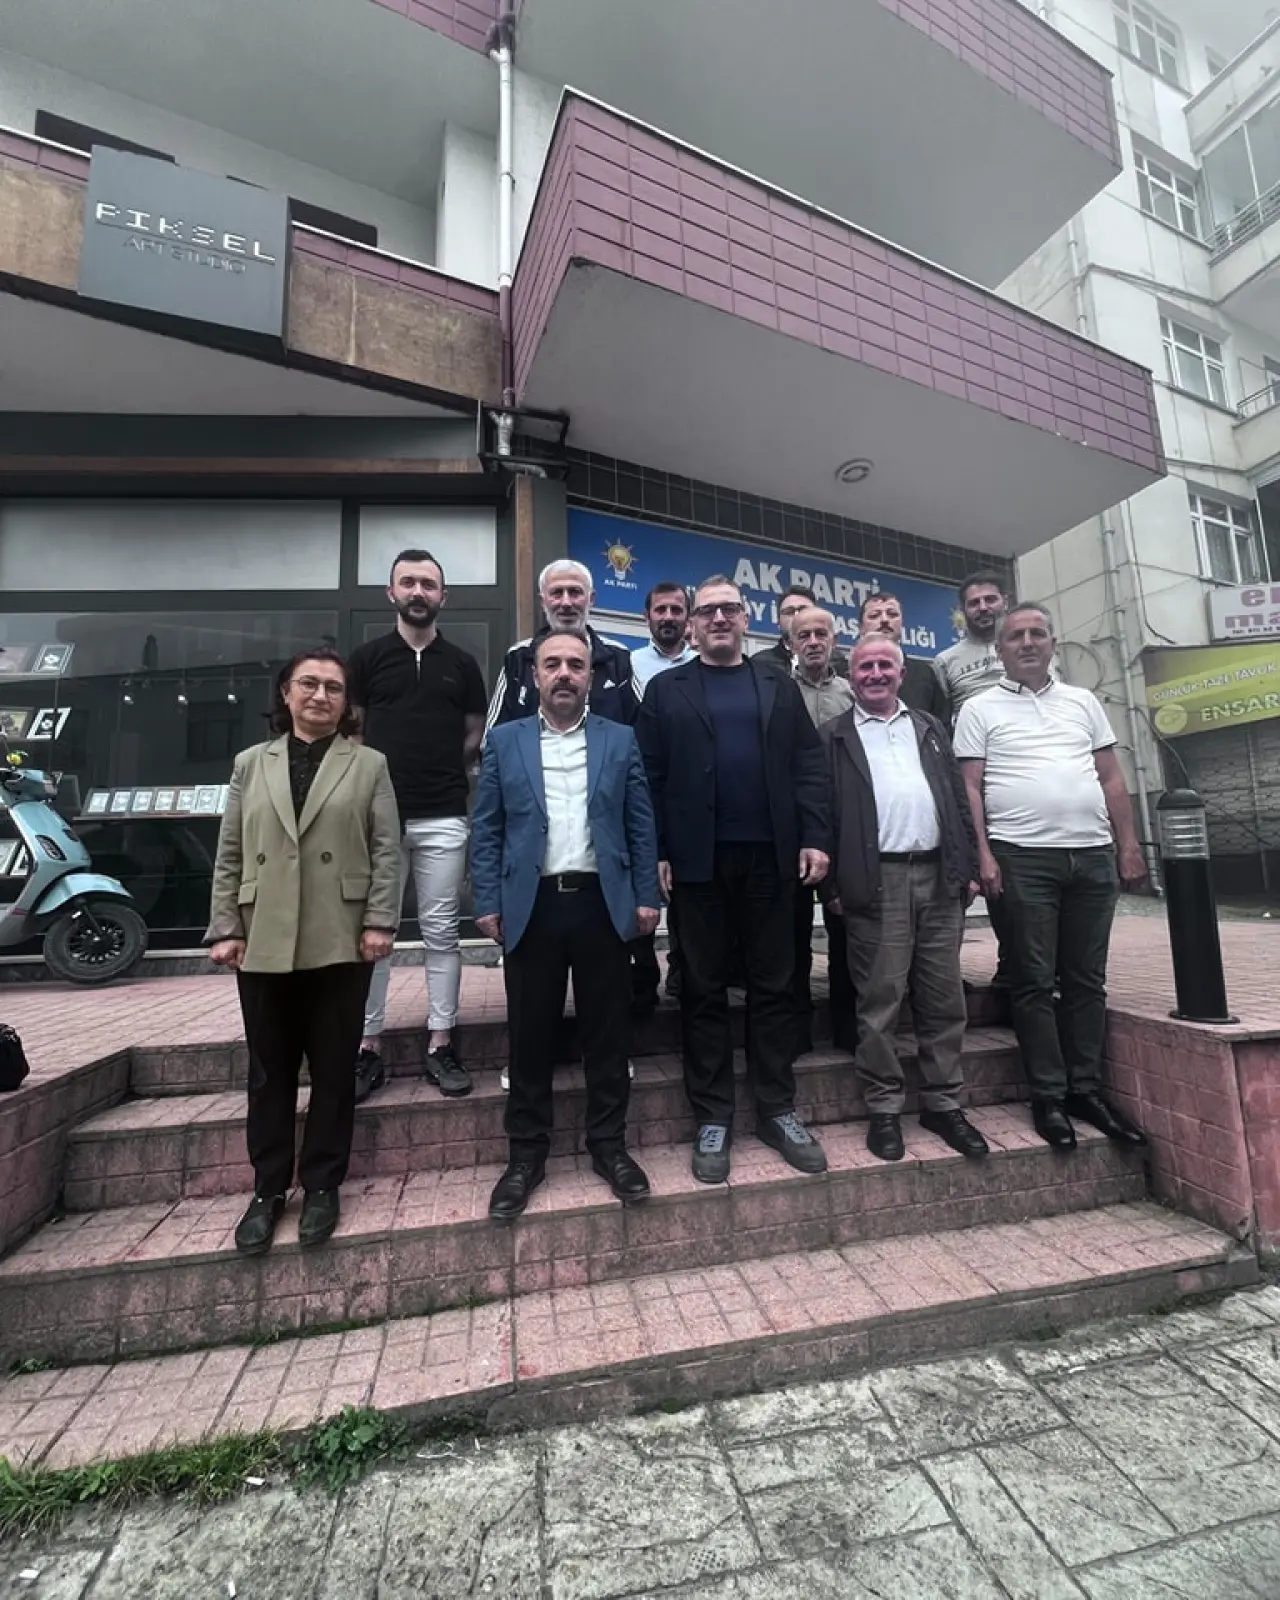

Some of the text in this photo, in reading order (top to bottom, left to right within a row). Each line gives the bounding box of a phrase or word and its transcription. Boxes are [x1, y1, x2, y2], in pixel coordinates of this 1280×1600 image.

[95, 203, 275, 262] PIKSEL
[604, 578, 615, 587] AK
[733, 557, 783, 595] AK
[831, 614, 936, 649] AŞLIĞI
[1202, 692, 1280, 722] ENSAR
